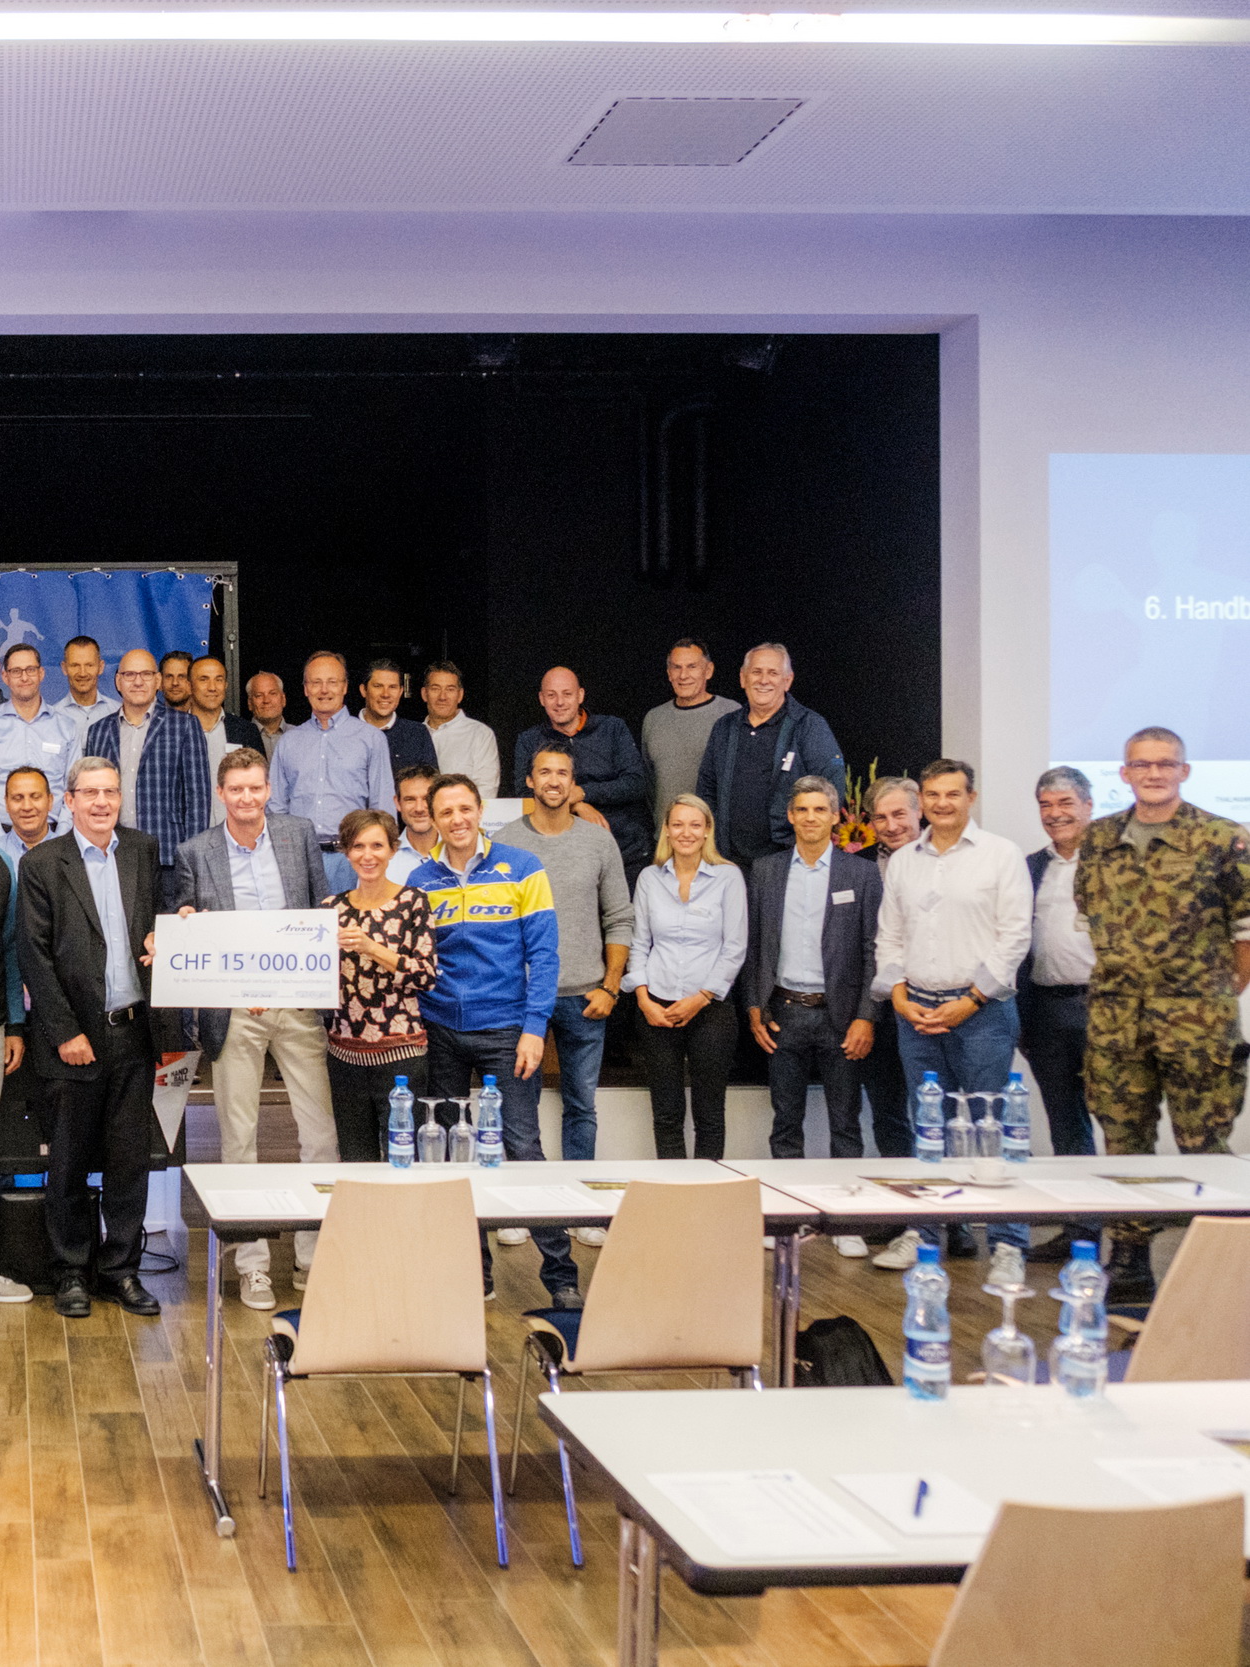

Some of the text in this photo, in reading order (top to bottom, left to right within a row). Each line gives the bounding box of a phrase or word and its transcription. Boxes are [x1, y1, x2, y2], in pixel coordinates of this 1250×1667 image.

[1144, 595, 1250, 620] 6. Handb
[276, 924, 314, 934] Arosa
[170, 953, 212, 970] CHF
